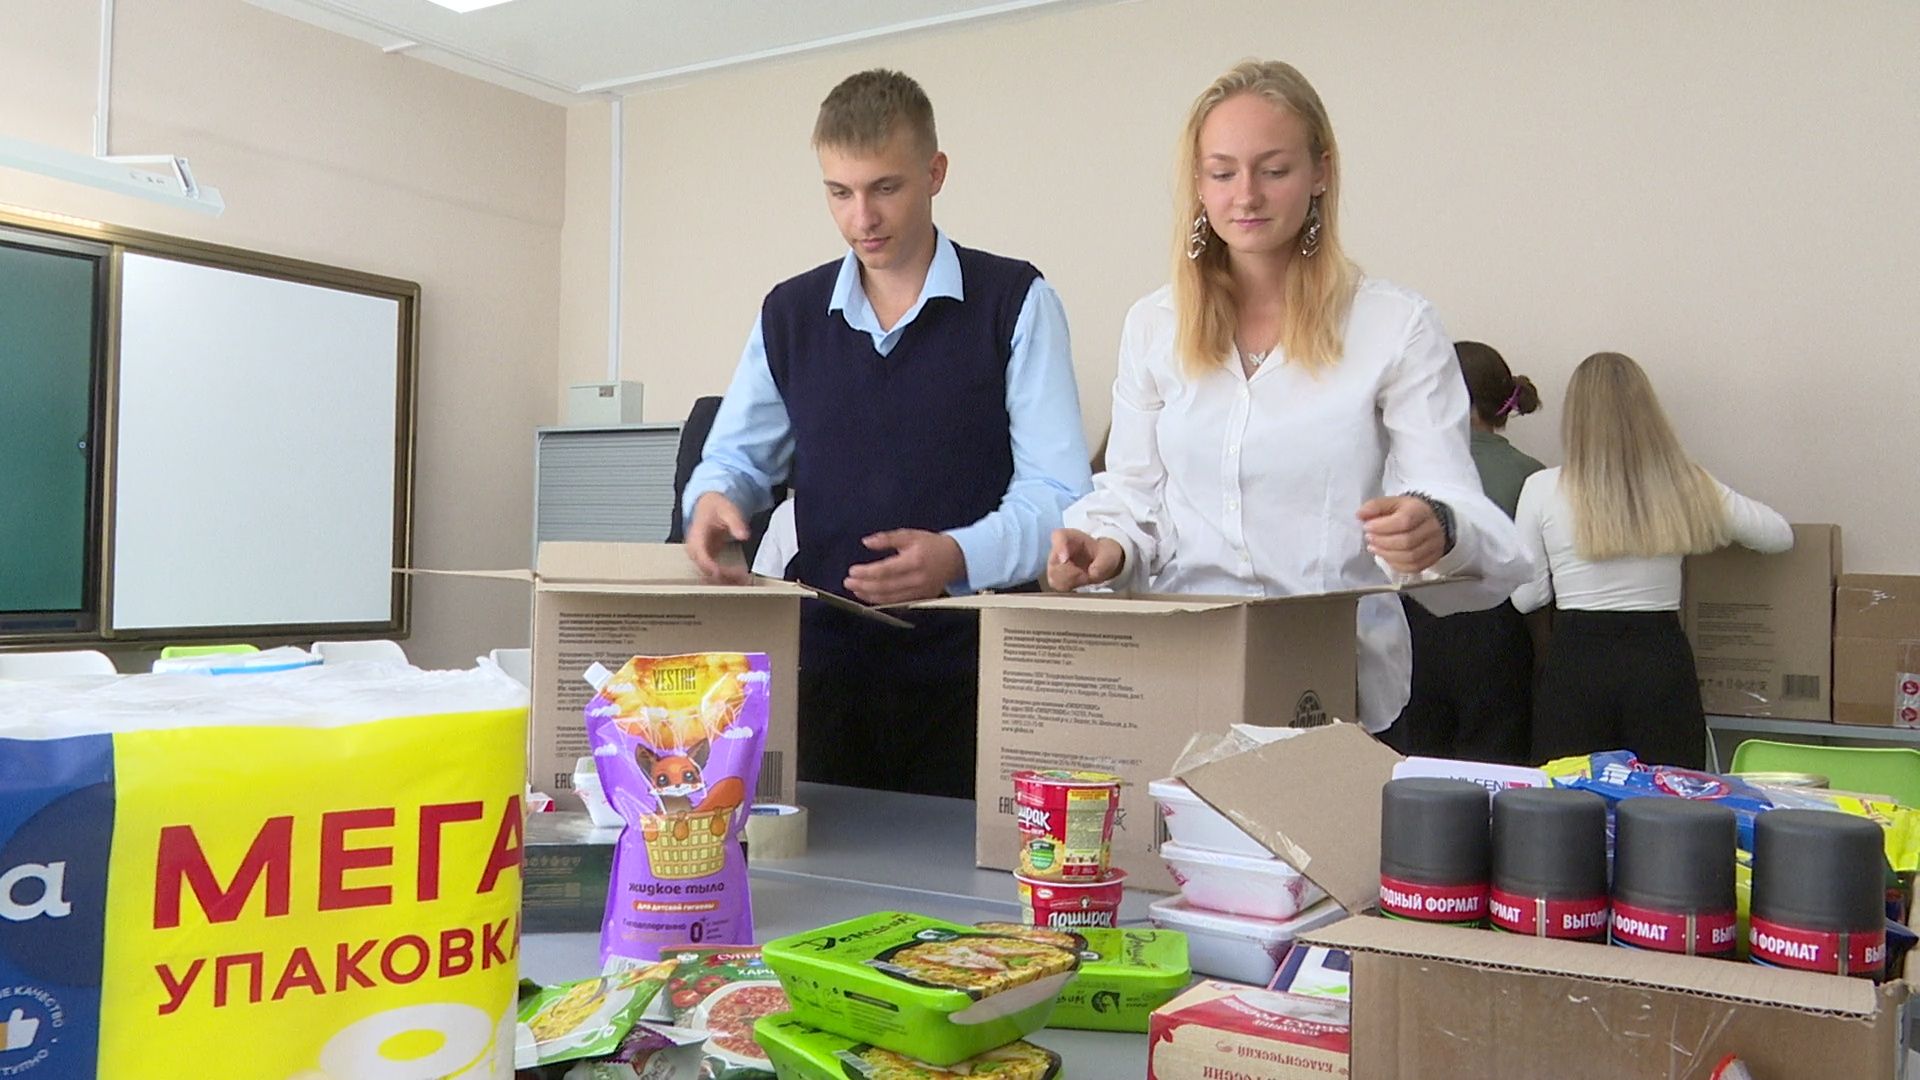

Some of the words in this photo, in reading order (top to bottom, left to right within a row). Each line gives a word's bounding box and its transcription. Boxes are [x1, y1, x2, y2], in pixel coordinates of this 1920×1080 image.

[629, 883, 682, 896] жидкое
[685, 882, 725, 894] мыло
[1425, 897, 1479, 913] ФОРМАТ
[1616, 914, 1668, 942] ФОРМАТ
[1759, 933, 1819, 961] ФОРМАТ
[1236, 1045, 1333, 1073] КЛАССИЧЕСКИЙ
